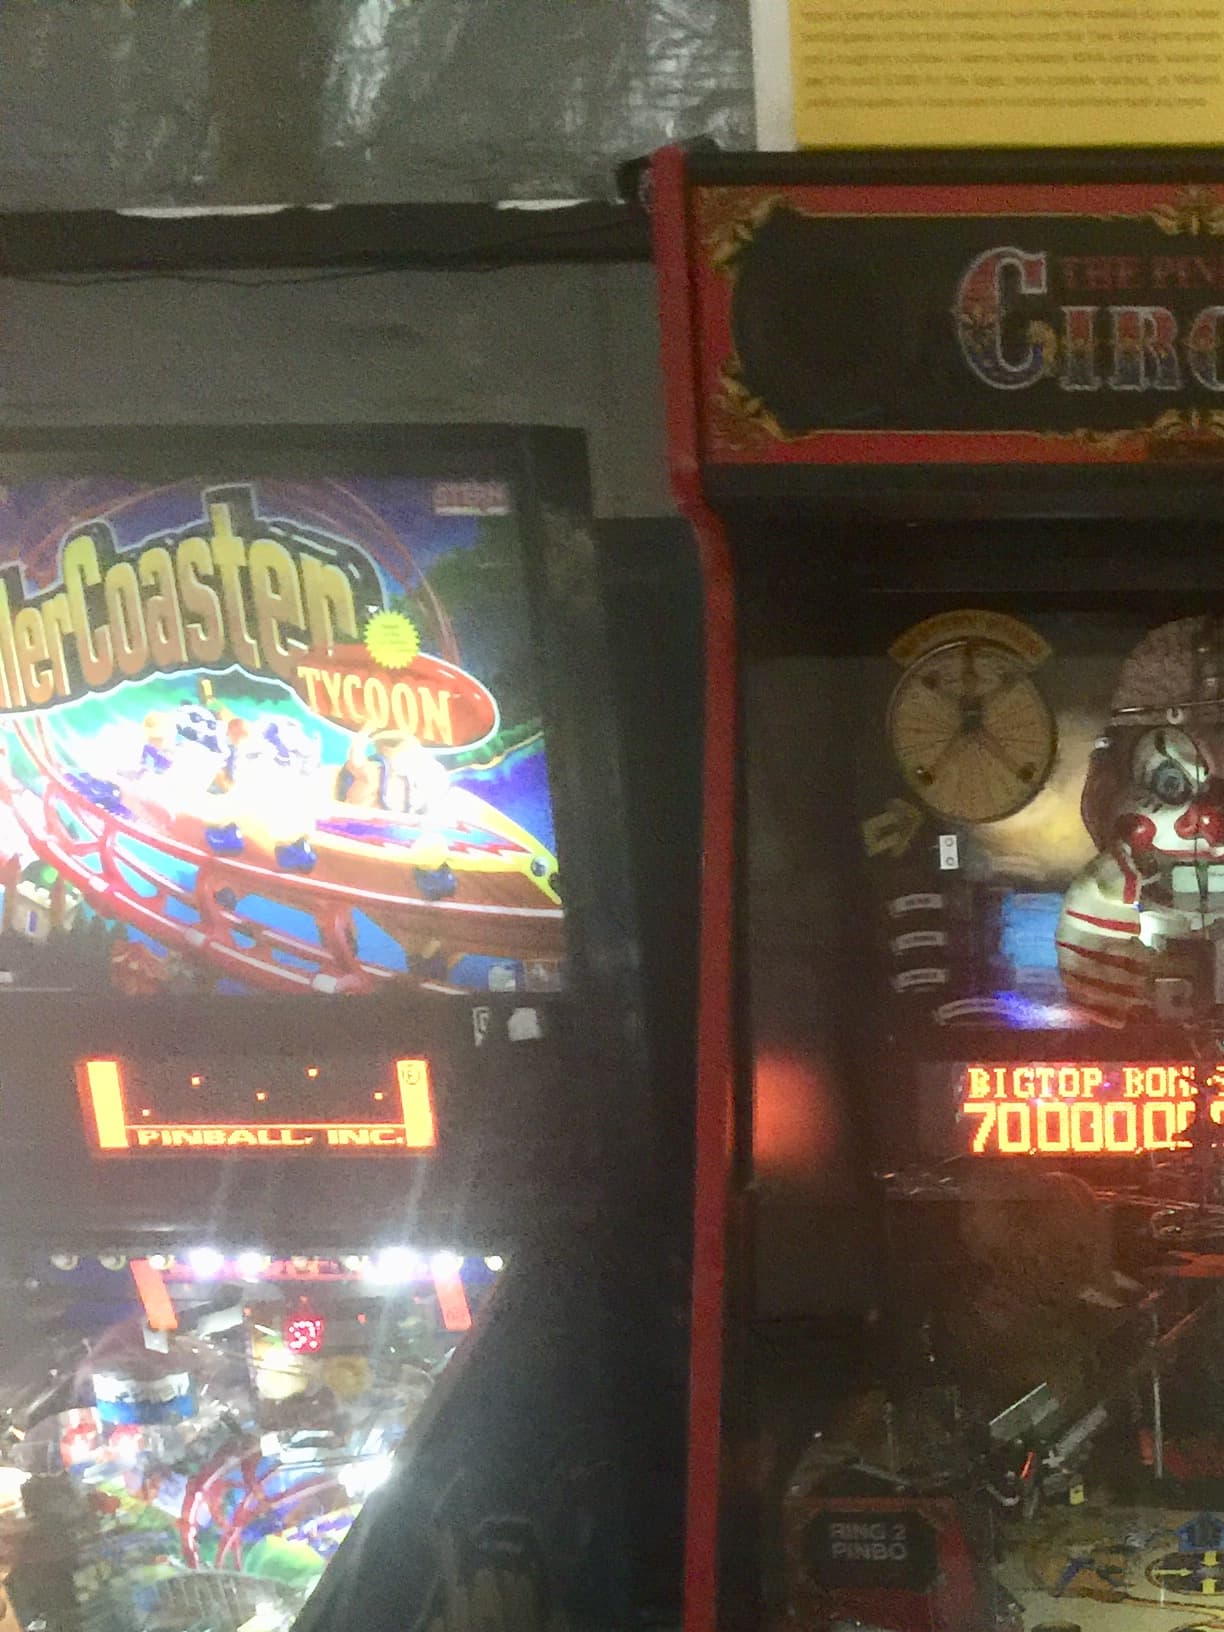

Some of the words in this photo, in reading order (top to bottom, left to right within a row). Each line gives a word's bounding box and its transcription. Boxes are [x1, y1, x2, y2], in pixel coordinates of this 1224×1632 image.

[1061, 255, 1139, 289] THE
[0, 501, 359, 708] lerCoaster
[298, 667, 456, 746] TYCOON
[967, 1066, 1102, 1099] BIGTOP
[326, 1128, 404, 1146] INC.
[830, 1522, 886, 1541] RING
[892, 1523, 907, 1541] 2
[830, 1541, 907, 1560] PINBO
